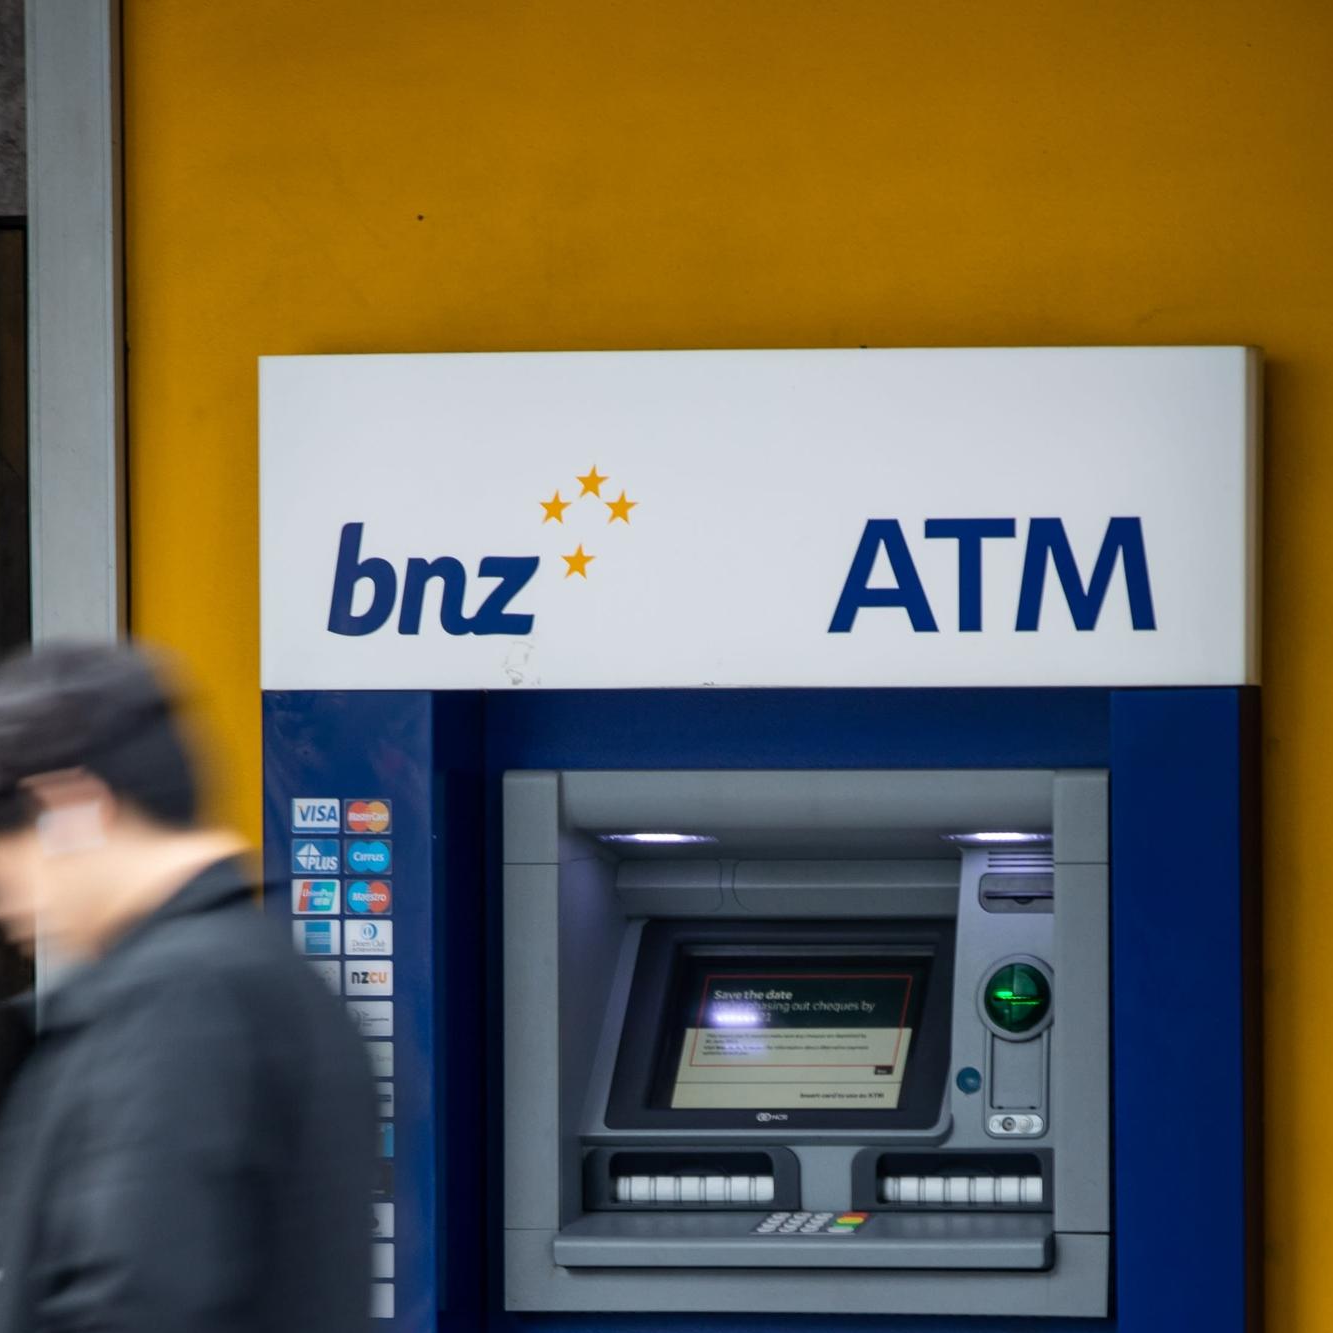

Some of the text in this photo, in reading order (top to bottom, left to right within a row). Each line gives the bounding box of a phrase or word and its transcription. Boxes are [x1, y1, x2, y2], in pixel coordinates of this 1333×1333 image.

[327, 522, 540, 637] bnz
[827, 517, 1157, 633] ATM
[298, 805, 338, 822] VISA
[308, 856, 339, 871] PLUS
[352, 851, 385, 862] Cirrus
[714, 990, 793, 1000] Save the date
[792, 1002, 810, 1011] out
[813, 1001, 859, 1013] cheques
[861, 1000, 875, 1013] by
